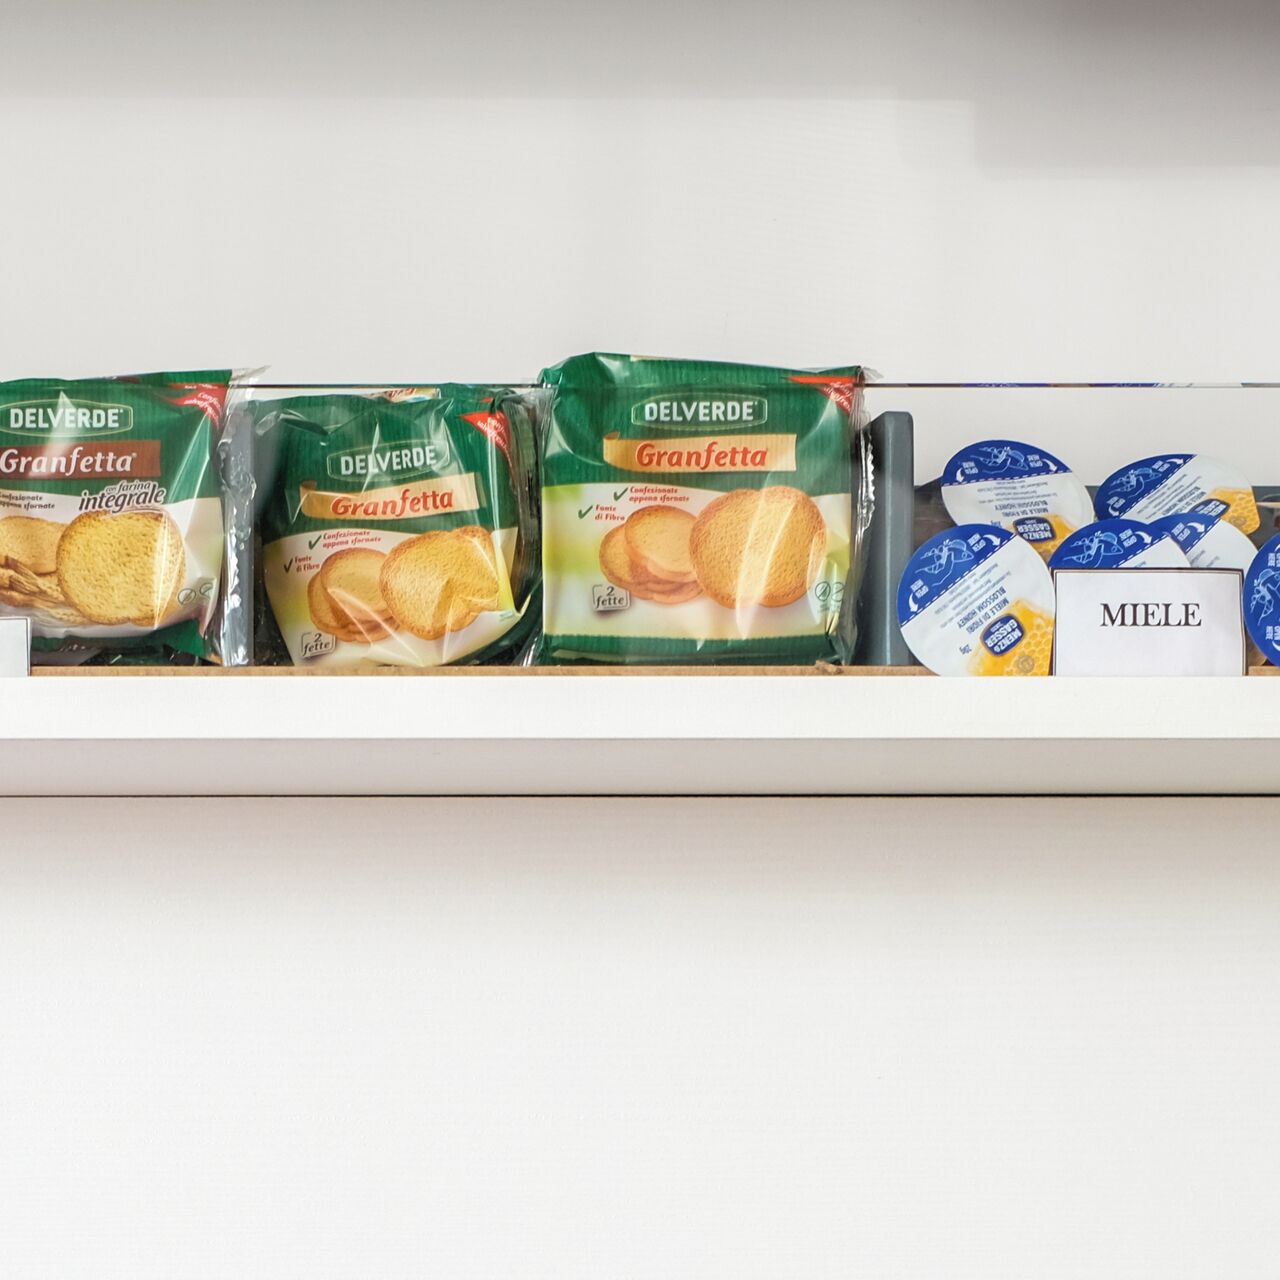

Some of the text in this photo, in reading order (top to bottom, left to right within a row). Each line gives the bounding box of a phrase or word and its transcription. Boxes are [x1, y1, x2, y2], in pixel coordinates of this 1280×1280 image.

[9, 408, 120, 429] DELVERDE
[644, 400, 754, 421] DELVERDE
[0, 447, 133, 476] Granfetta
[340, 446, 437, 476] DELVERDE
[636, 442, 768, 471] Granfetta
[116, 481, 151, 493] farina
[629, 486, 678, 495] Confezionate
[78, 486, 166, 514] integrale
[331, 489, 454, 518] Granfetta
[596, 504, 617, 512] Fonte
[605, 513, 625, 521] Fibra
[1016, 521, 1050, 533] GASSER
[606, 586, 615, 597] 2
[596, 595, 625, 609] fette
[954, 585, 1006, 628] BLOSSOM HONEY
[988, 597, 1010, 615] MIELE
[1100, 602, 1202, 627] MIELE
[964, 617, 984, 634] FIORI
[985, 619, 1018, 648] GASSER
[314, 632, 322, 642] 2
[303, 640, 331, 657] fette
